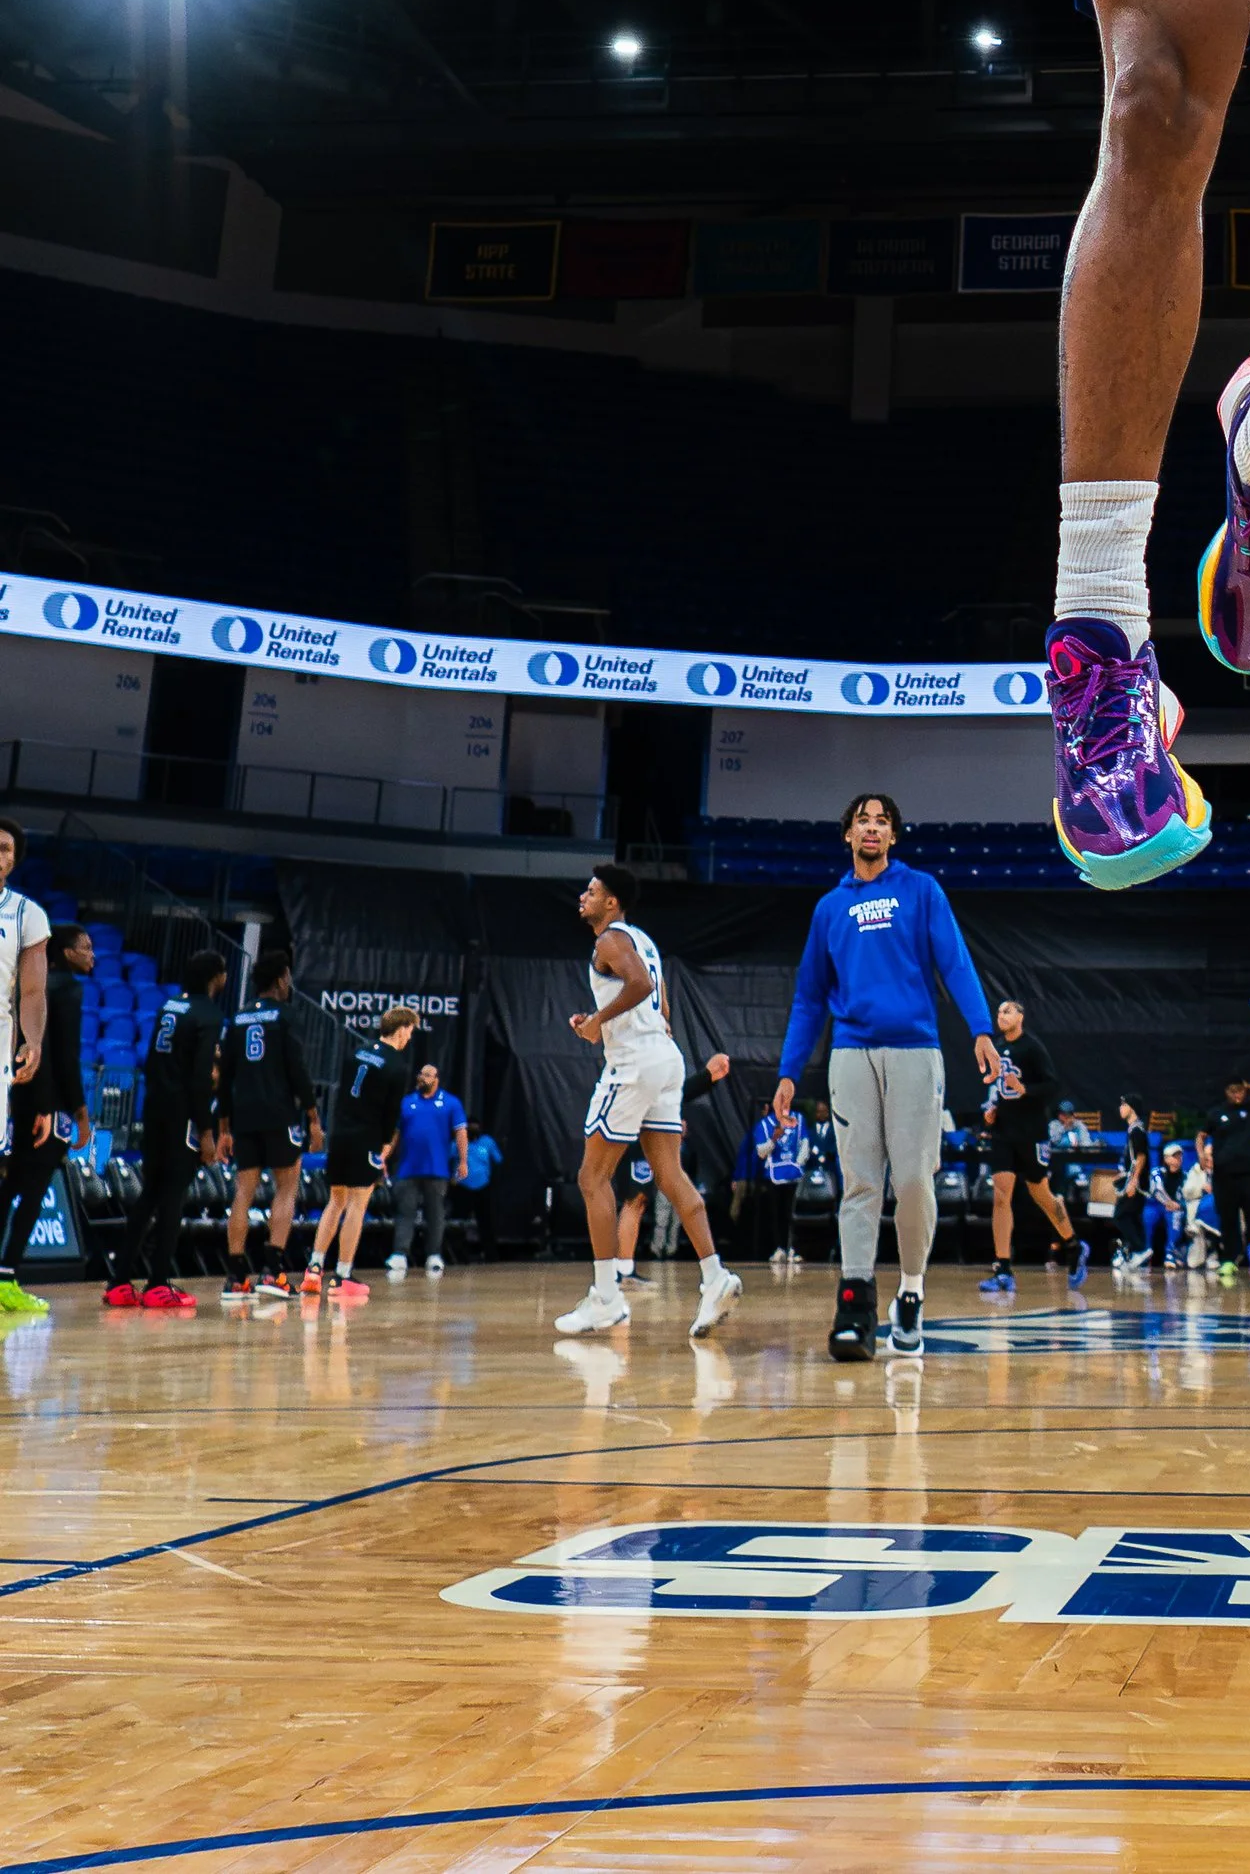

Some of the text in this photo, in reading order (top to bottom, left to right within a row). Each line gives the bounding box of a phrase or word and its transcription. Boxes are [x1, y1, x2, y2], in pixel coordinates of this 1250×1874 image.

[991, 234, 1061, 251] GEORGIA
[998, 254, 1053, 272] STATE
[105, 599, 178, 624] United
[102, 618, 182, 644] Rentals
[269, 622, 337, 647] United
[266, 641, 340, 666] Rentals
[422, 643, 493, 664] United
[420, 661, 497, 682] Rentals
[585, 654, 653, 675] United
[741, 665, 808, 684] United
[582, 672, 658, 693] Rentals
[895, 672, 960, 690] United
[740, 682, 813, 702] Rentals
[893, 690, 965, 706] Rentals
[719, 730, 744, 744] 207
[720, 757, 742, 772] 105
[848, 897, 899, 917] GEORGIA
[857, 908, 894, 925] STATE
[321, 990, 460, 1026] NORTHSIDE
[155, 1012, 177, 1054] 2
[345, 1014, 433, 1032] HOSL
[245, 1024, 266, 1062] 6
